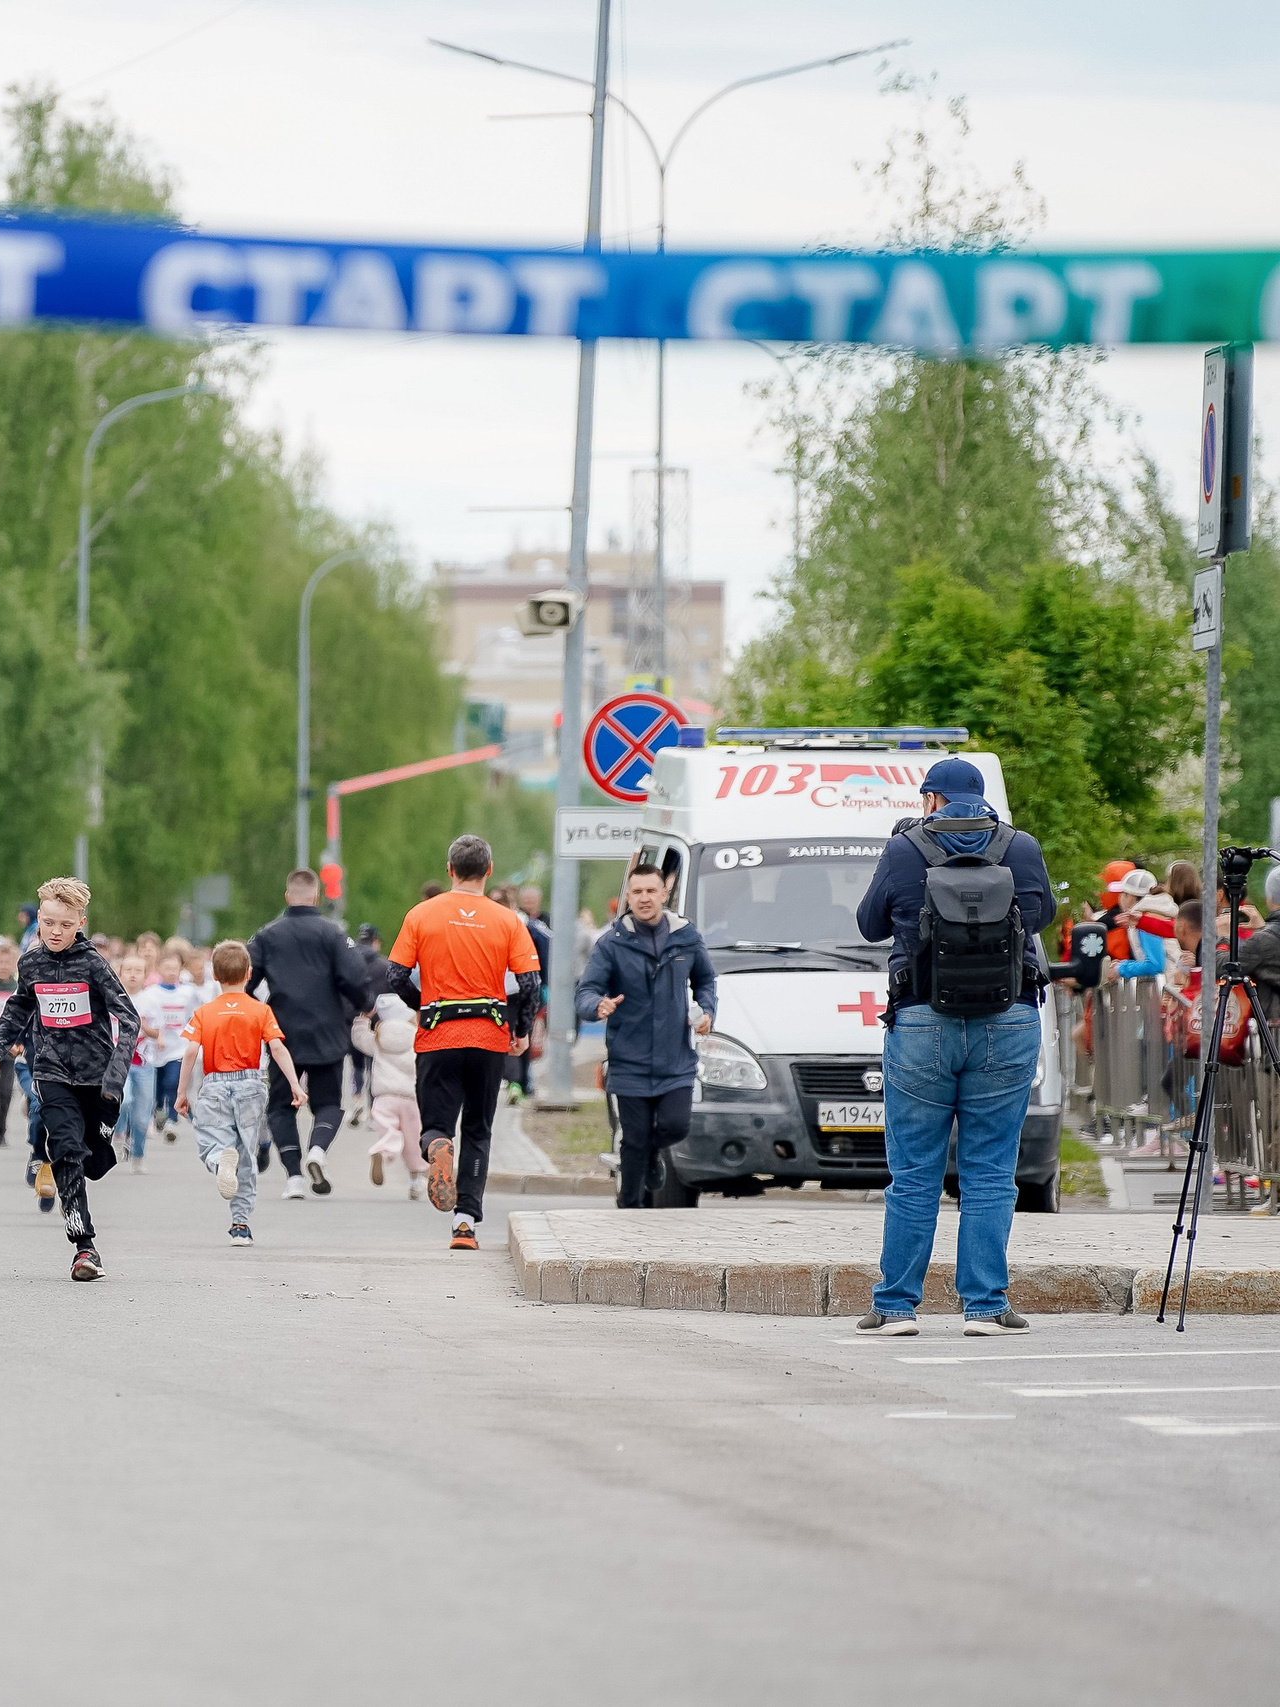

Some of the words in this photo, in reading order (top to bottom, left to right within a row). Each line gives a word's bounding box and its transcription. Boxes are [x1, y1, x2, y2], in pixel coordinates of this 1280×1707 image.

[140, 240, 610, 340] СТАРТ
[686, 255, 1164, 348] СТАРТ
[716, 764, 816, 799] 103
[810, 786, 882, 811] Скорая
[715, 846, 764, 869] 03
[48, 1002, 76, 1013] 2770
